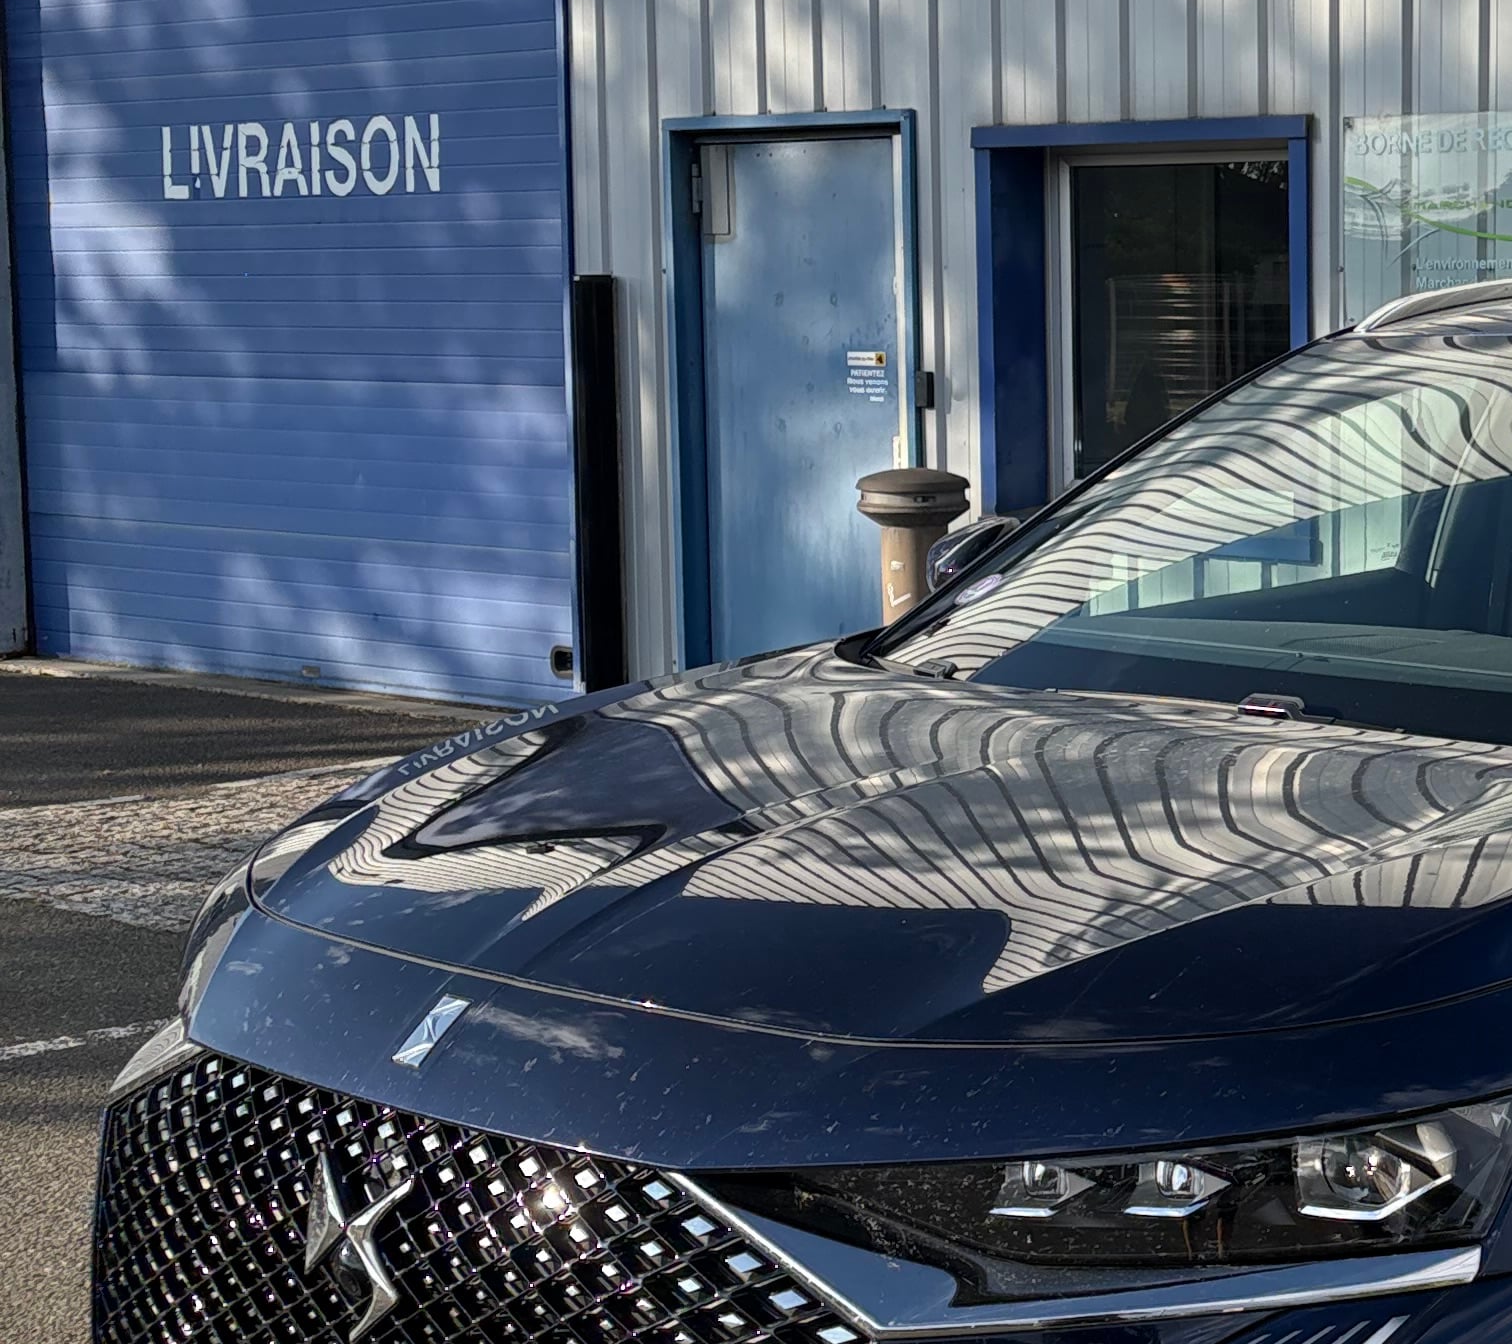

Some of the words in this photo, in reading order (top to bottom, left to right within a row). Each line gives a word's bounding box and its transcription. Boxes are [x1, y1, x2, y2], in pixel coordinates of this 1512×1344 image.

[162, 113, 440, 199] LIVRAISON
[1356, 130, 1433, 155] BORNE
[1437, 129, 1467, 153] DE
